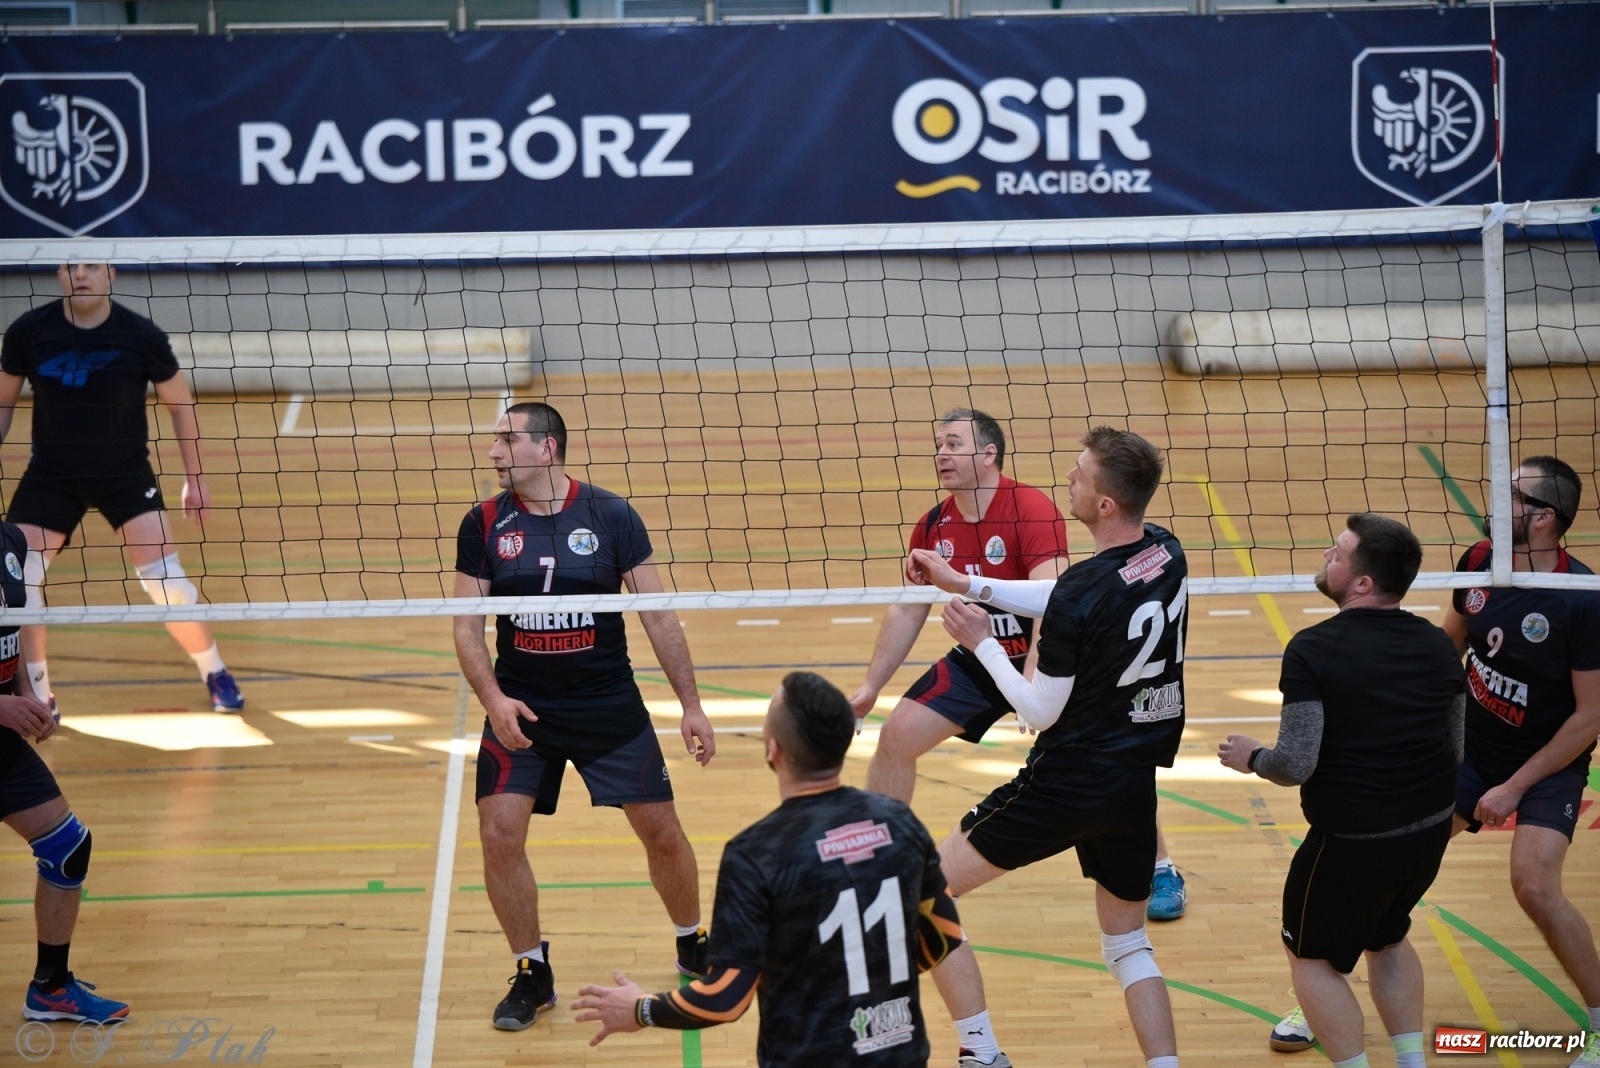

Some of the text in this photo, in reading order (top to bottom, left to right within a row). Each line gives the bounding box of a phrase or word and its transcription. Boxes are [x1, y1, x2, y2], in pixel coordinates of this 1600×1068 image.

[239, 94, 694, 186] RACIBÓRZ
[997, 164, 1152, 195] RACIBÓRZ
[539, 556, 556, 593] 7
[1123, 550, 1167, 580] PIWIARNIA
[514, 629, 596, 651] NORTHERN
[1116, 575, 1188, 688] 21
[1487, 627, 1504, 659] 9
[818, 876, 910, 997] 11
